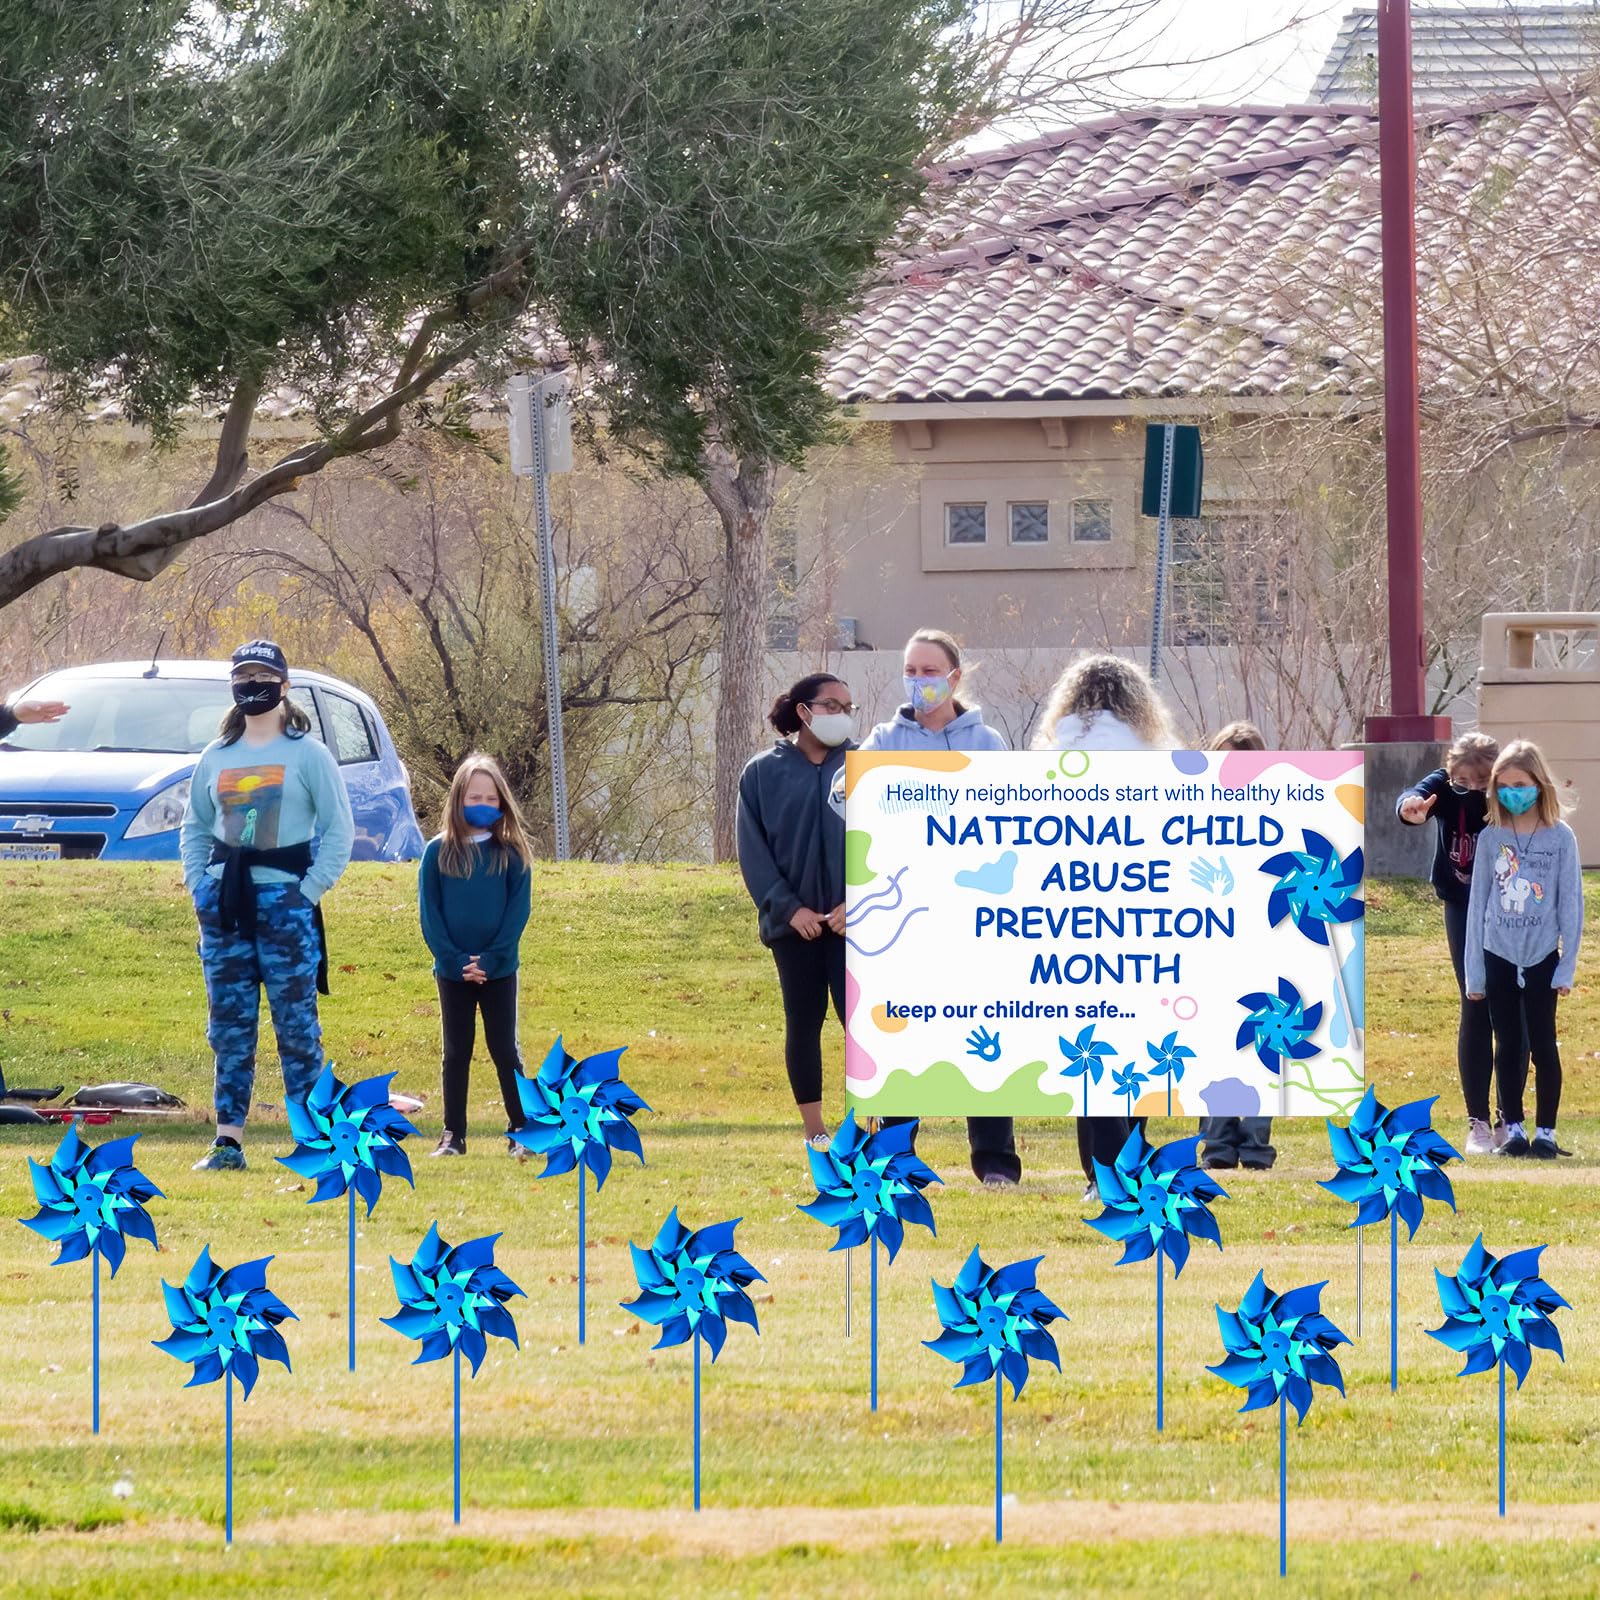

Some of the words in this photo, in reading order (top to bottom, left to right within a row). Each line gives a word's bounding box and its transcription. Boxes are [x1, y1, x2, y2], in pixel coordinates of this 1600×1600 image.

[886, 783, 960, 806] Healthy
[966, 783, 1110, 806] neighborhoods
[1115, 785, 1159, 802] start
[1164, 783, 1204, 802] with
[1211, 783, 1281, 806] healthy
[1287, 783, 1325, 802] kids
[926, 814, 1145, 847] NATIONAL
[1161, 814, 1284, 847] CHILD
[1040, 859, 1171, 893] ABUSE
[975, 906, 1235, 939] PREVENTION
[1029, 953, 1181, 985] MONTH
[886, 1000, 937, 1024] keep
[942, 1005, 978, 1019] our
[983, 1000, 1069, 1019] children
[1074, 1000, 1136, 1019] safe...
